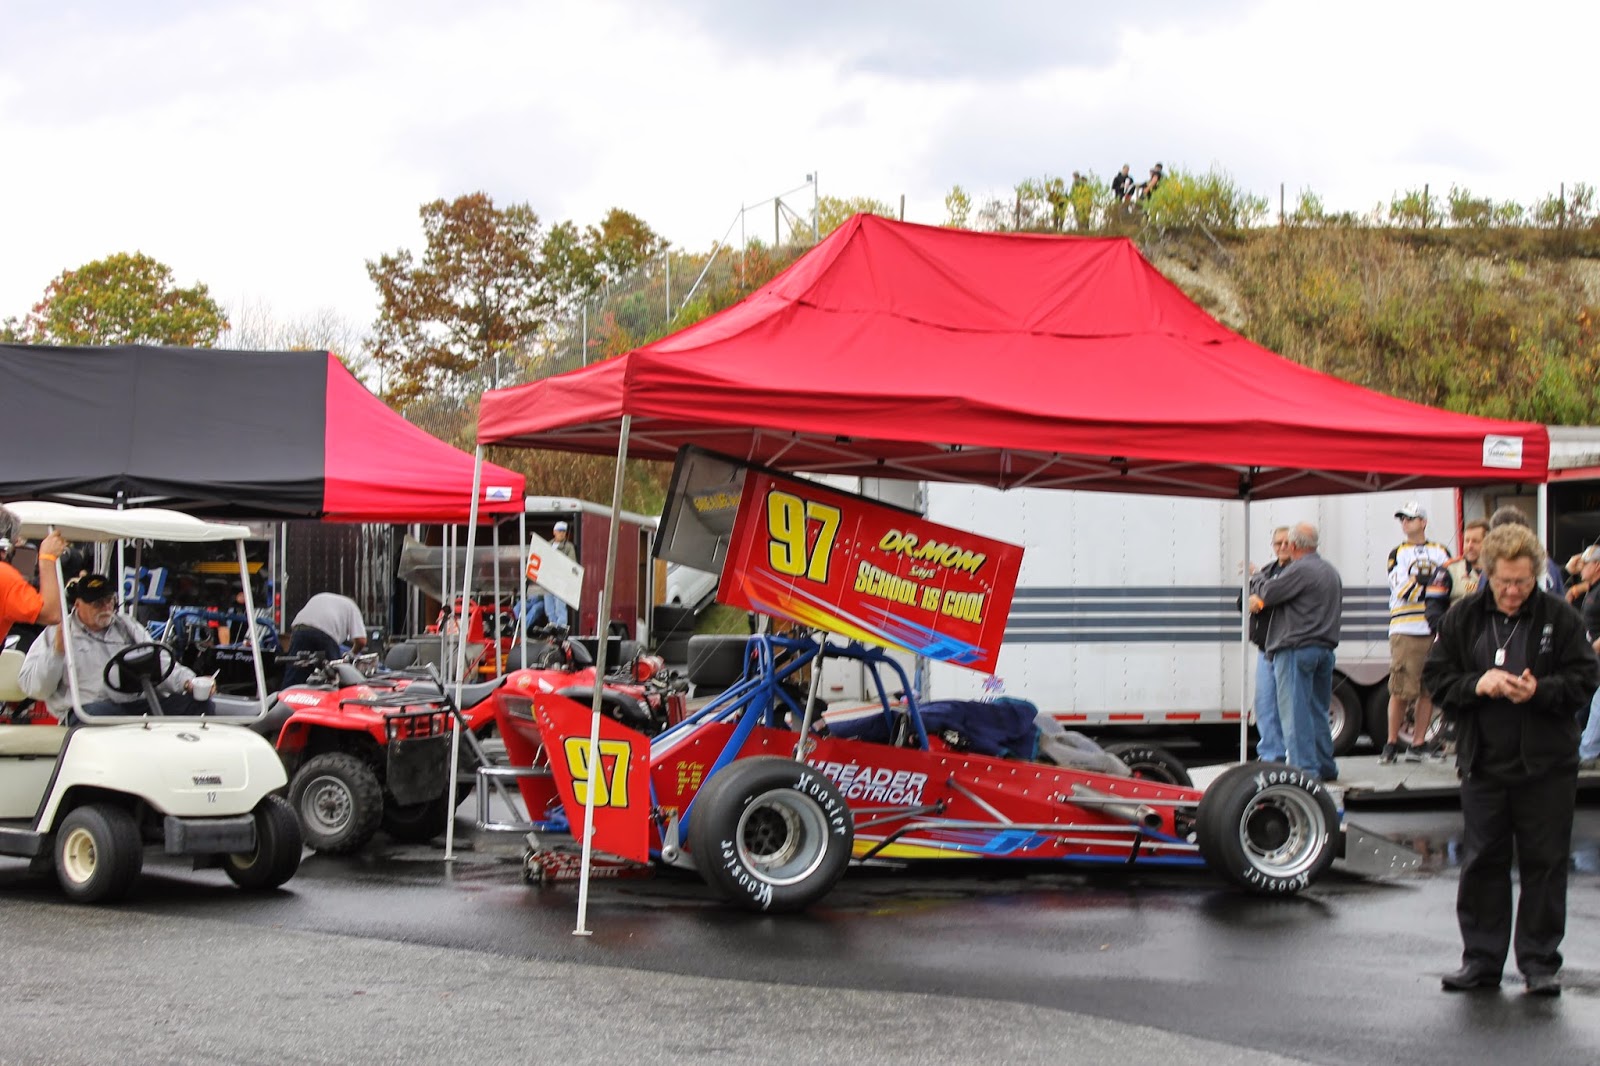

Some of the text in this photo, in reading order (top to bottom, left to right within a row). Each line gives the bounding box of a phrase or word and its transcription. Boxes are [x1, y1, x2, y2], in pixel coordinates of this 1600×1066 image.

[527, 553, 541, 582] 2
[767, 491, 842, 584] 97
[879, 529, 987, 574] DR.MOM
[123, 566, 167, 603] 51
[854, 560, 985, 624] SCHOOL IS COOL
[207, 791, 217, 802] 12
[563, 736, 631, 808] 97
[793, 772, 847, 835] Hoosier
[720, 840, 774, 911] Hoosier
